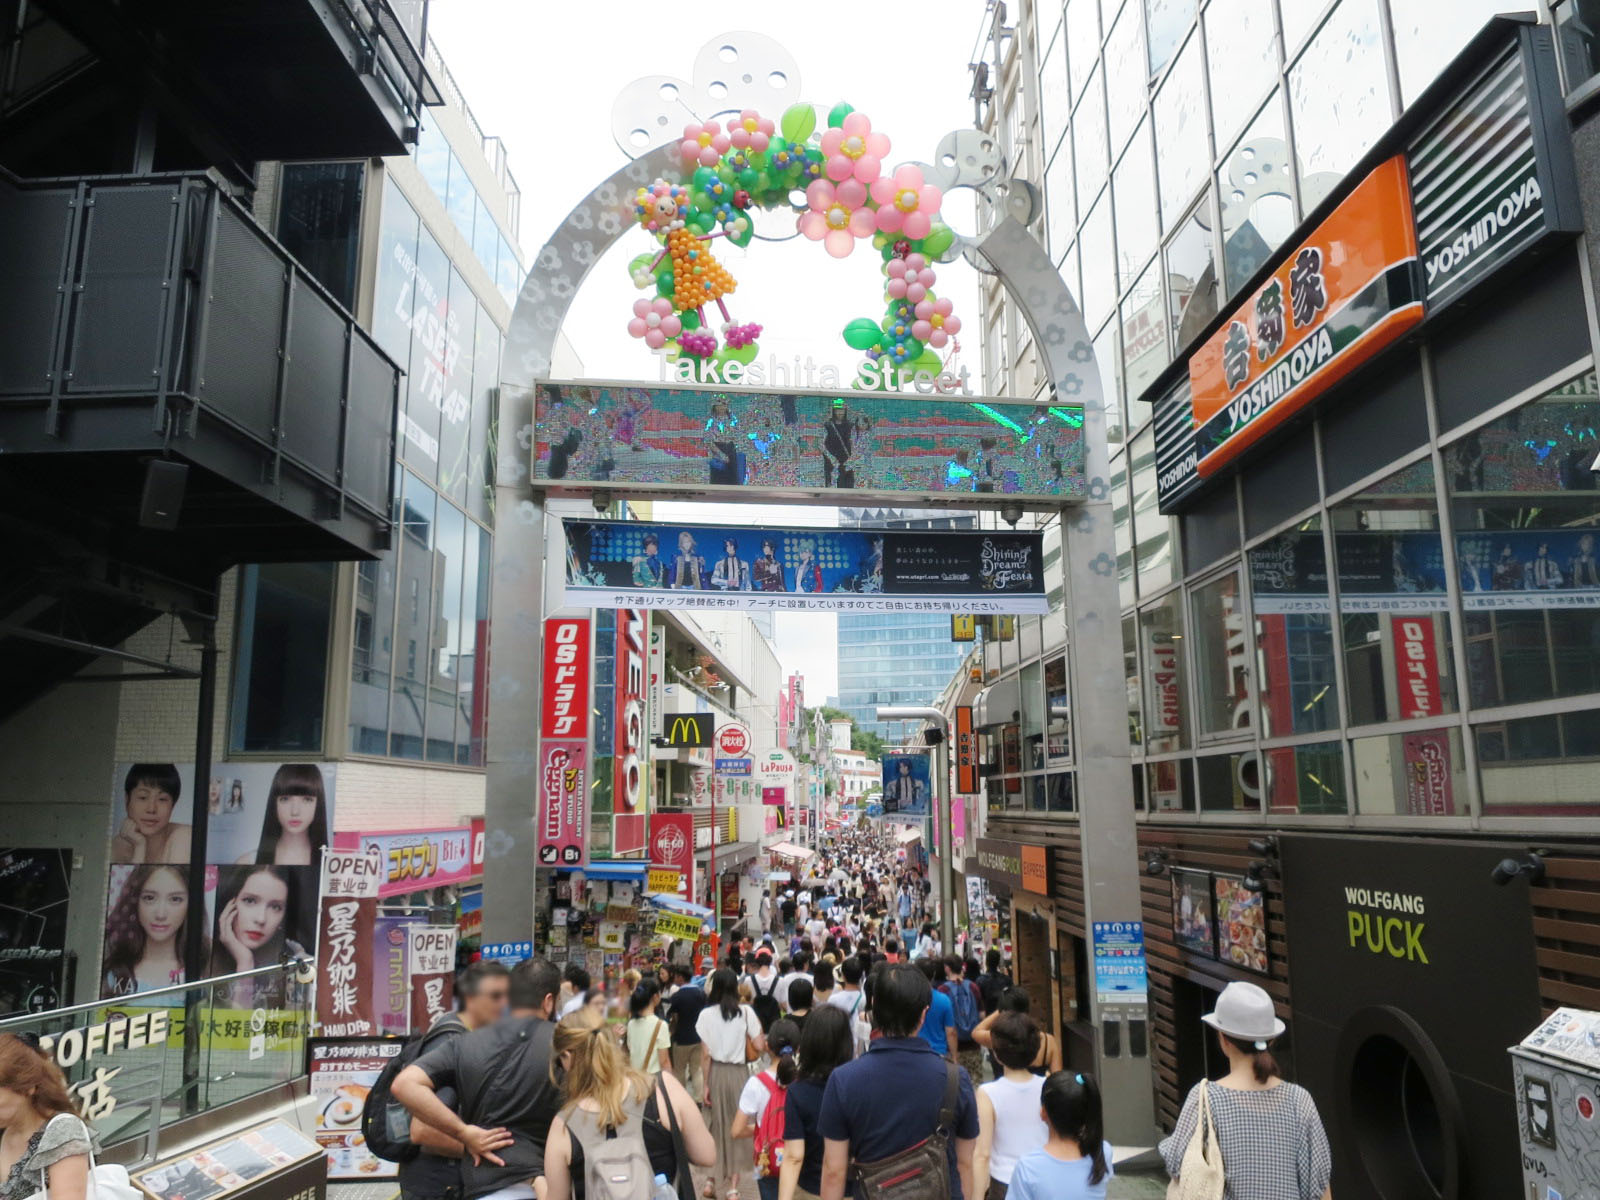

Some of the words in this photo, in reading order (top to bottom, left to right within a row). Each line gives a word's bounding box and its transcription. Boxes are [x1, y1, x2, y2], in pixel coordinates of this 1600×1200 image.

[1425, 175, 1542, 285] YOSHINOYA
[393, 281, 461, 377] LASER
[420, 356, 470, 424] TRAP
[651, 347, 841, 389] Takeshita
[856, 357, 973, 395] Street
[1226, 327, 1334, 431] YOSHINOYA
[981, 537, 1032, 564] Shining
[981, 558, 1026, 577] Dream
[993, 570, 1034, 589] Festa
[553, 624, 578, 734] OSドラッグ
[721, 736, 744, 747] 消火栓
[760, 762, 770, 773] La
[771, 762, 793, 773] Pausa
[547, 748, 568, 838] eggnam
[576, 769, 585, 838] ENTERTAINMENT
[328, 857, 378, 876] OPEN
[388, 838, 439, 883] コスプリ
[565, 849, 579, 861] B1
[1345, 887, 1425, 915] WOLFGANG
[415, 934, 454, 951] OPEN
[1348, 910, 1429, 964] PUCK
